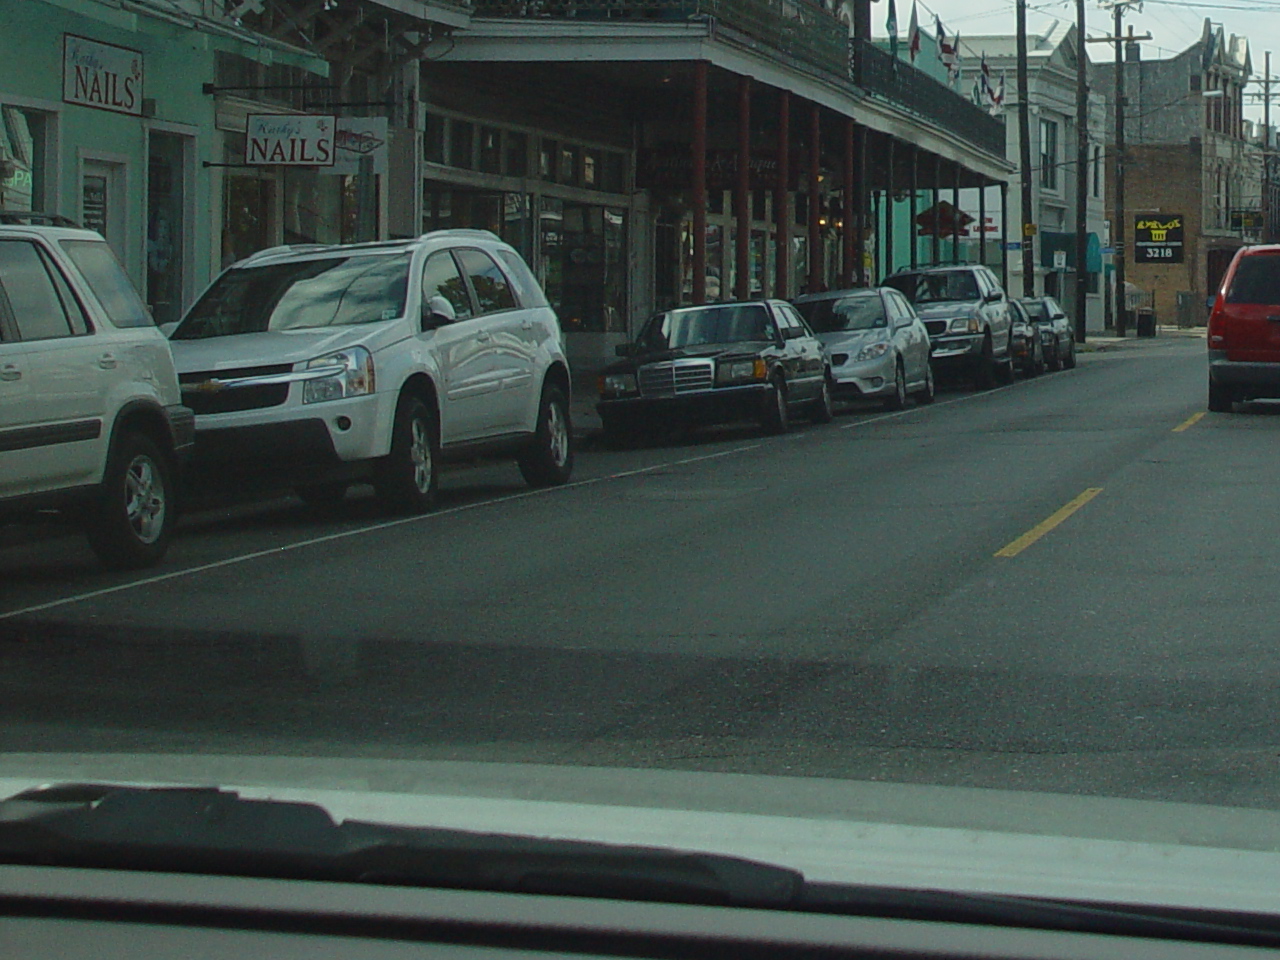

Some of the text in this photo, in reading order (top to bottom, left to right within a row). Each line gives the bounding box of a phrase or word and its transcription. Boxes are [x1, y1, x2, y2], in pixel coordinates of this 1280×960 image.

[74, 65, 135, 109] NAILS
[250, 138, 330, 162] NAILS
[1146, 248, 1172, 258] 3218
